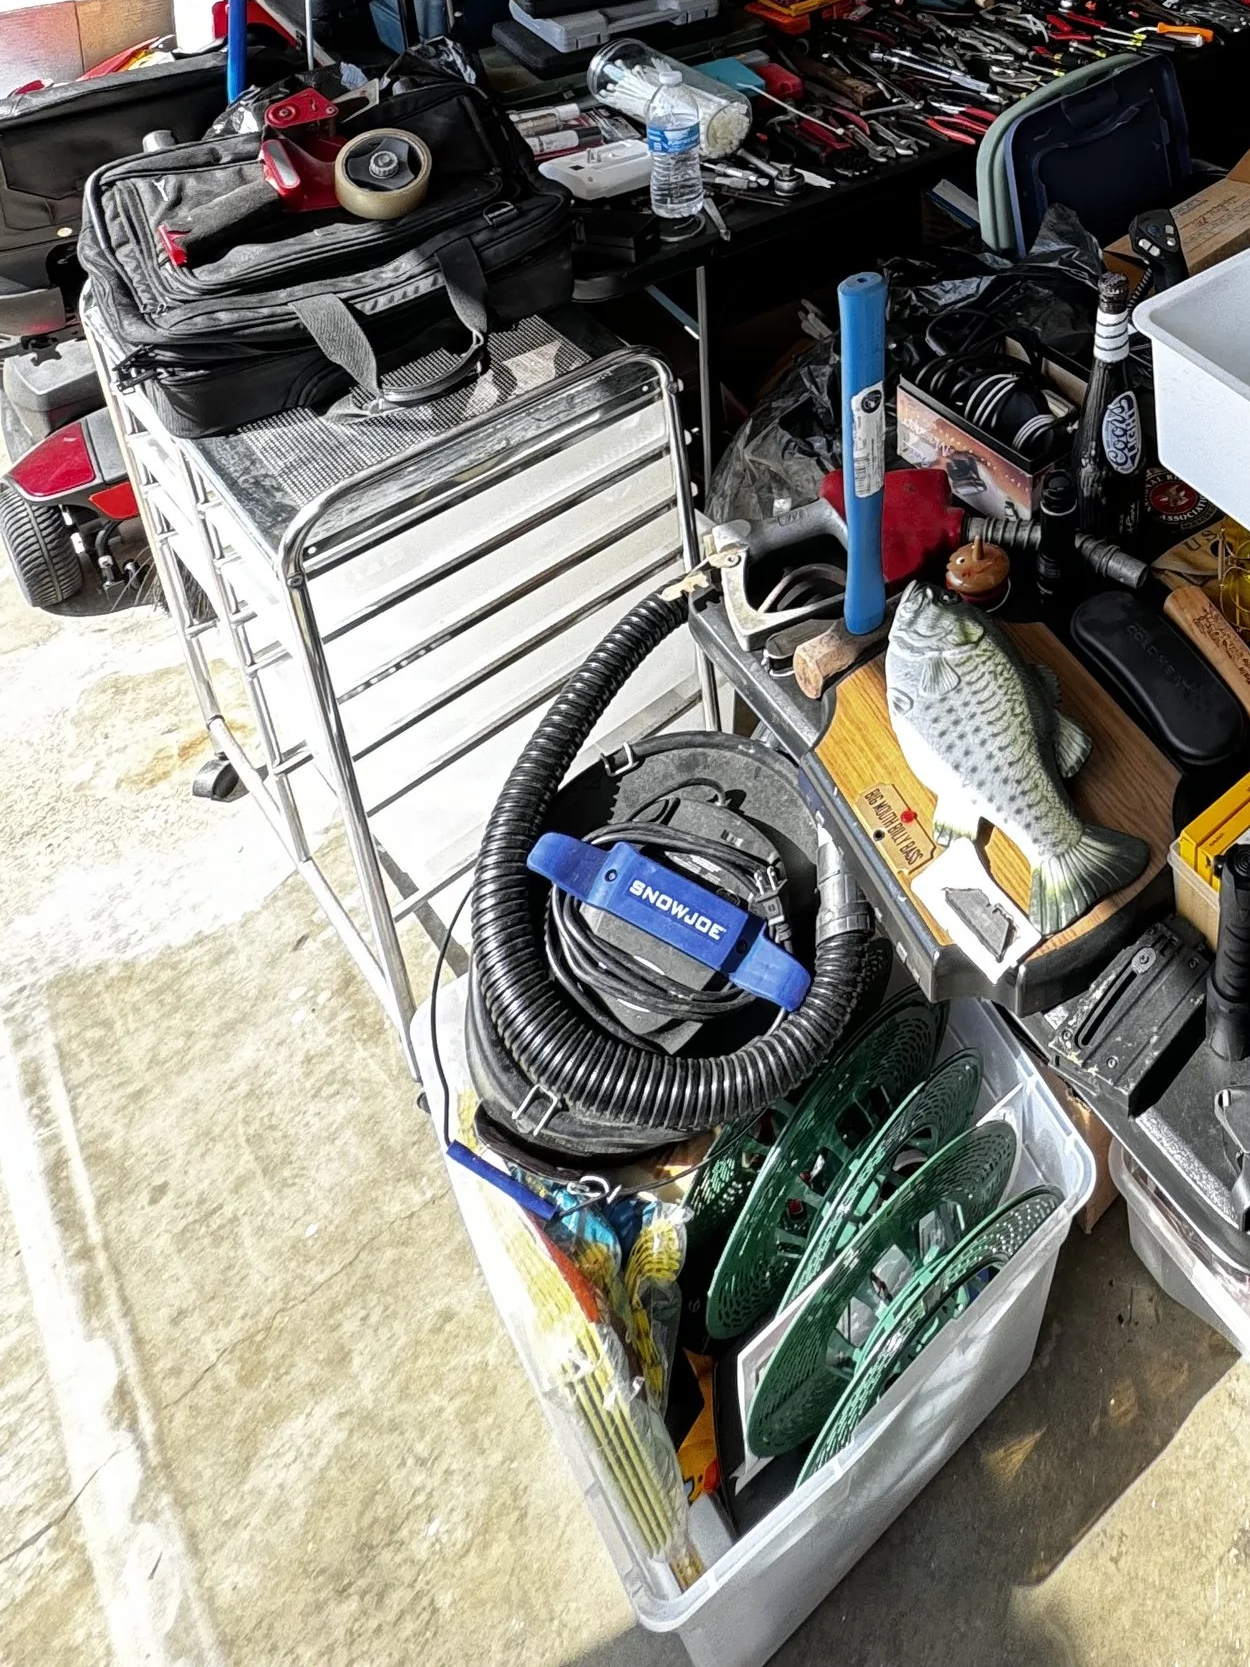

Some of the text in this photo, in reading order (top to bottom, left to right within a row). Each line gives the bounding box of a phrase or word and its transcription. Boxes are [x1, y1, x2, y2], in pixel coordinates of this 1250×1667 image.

[1107, 394, 1135, 467] Coors
[1159, 495, 1209, 522] ASSOCIATI
[864, 788, 924, 866] BIG MOUTH BILLY BASS
[629, 879, 728, 941] SNOWJOE
